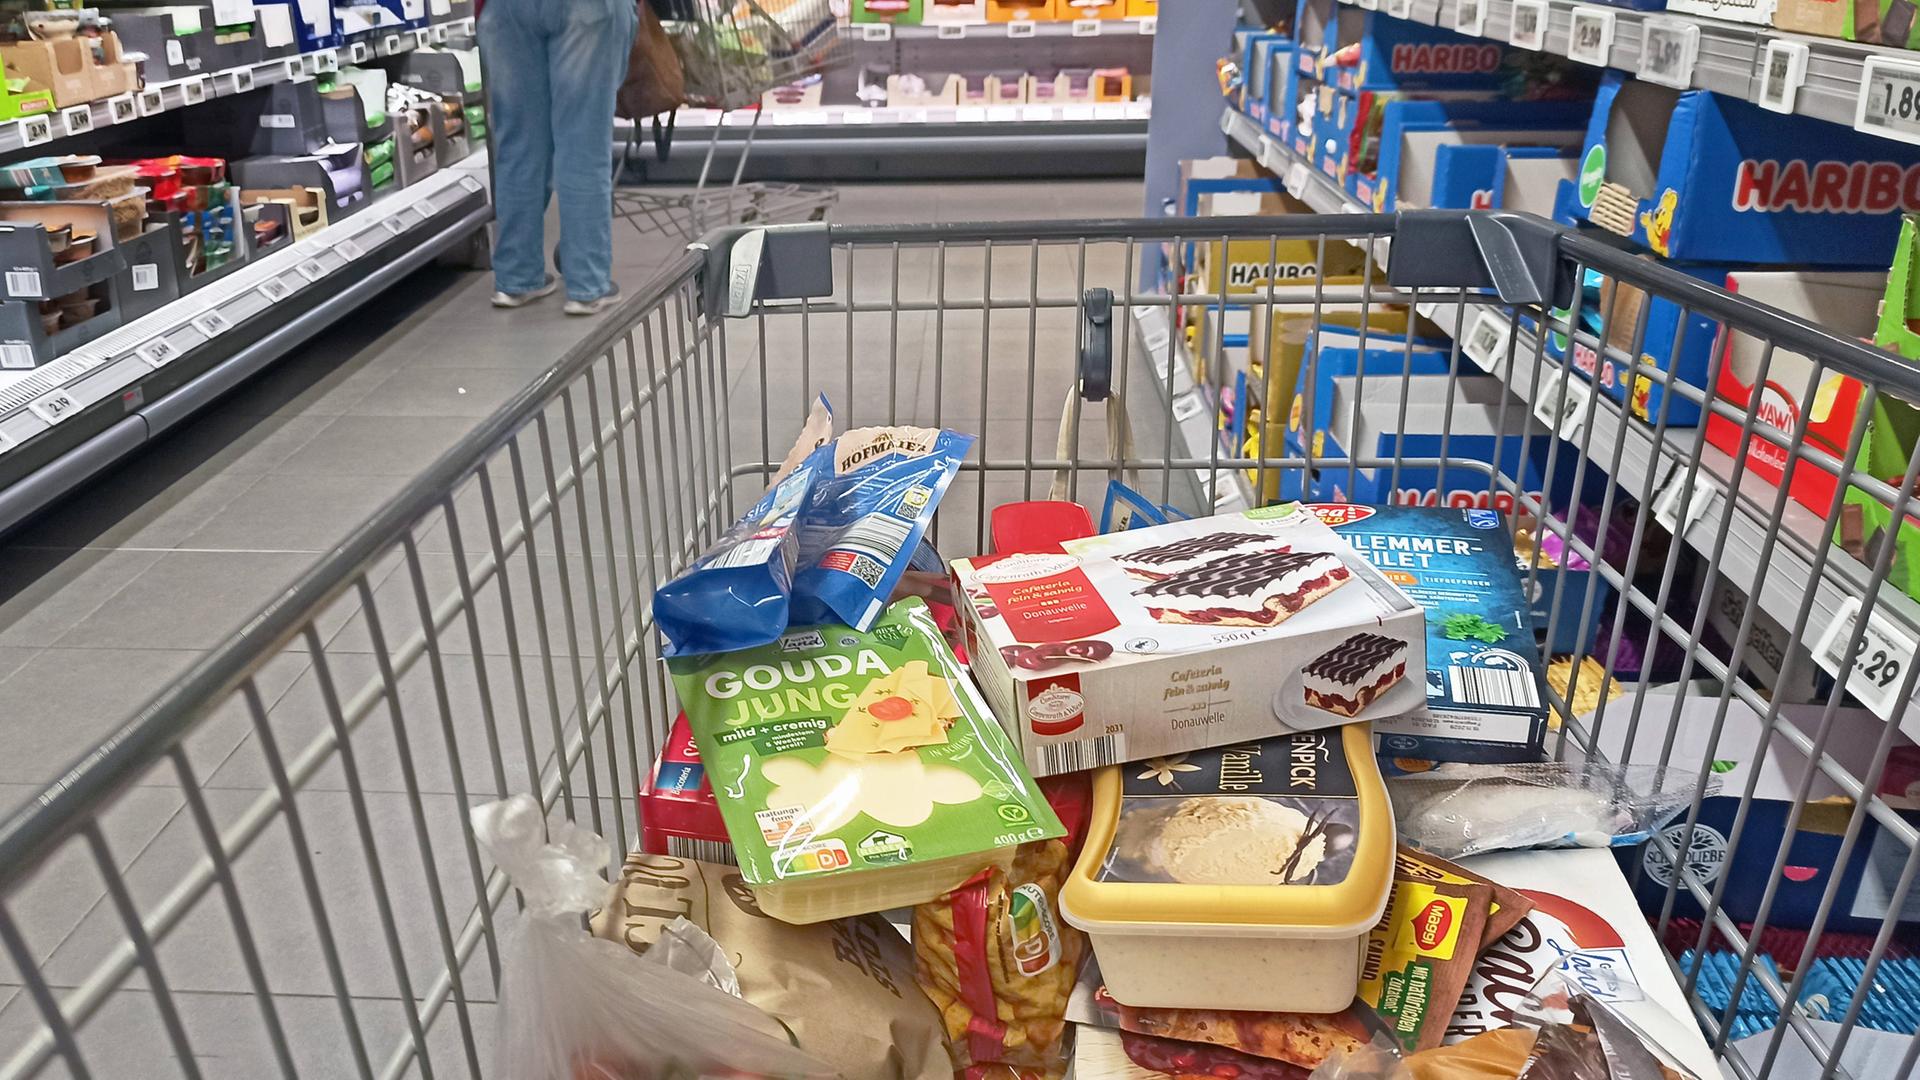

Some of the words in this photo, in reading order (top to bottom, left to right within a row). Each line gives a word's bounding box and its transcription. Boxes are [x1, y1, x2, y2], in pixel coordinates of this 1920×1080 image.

[1392, 44, 1498, 73] HARIBO
[841, 440, 928, 472] HOFMAIER
[1338, 533, 1483, 556] HLEMMER-
[1007, 593, 1031, 605] fein
[1042, 585, 1083, 598] sahnig
[1013, 580, 1071, 595] Cafeteria
[1023, 602, 1088, 620] Donauwelle
[1213, 633, 1238, 644] 550
[1240, 632, 1250, 642] g
[704, 649, 891, 699] GOUDA
[1171, 665, 1222, 682] Cafeteria
[723, 682, 858, 727] JUNG
[1105, 724, 1123, 734] 2031
[1171, 712, 1225, 730] Donauwelle
[722, 726, 756, 742] mild
[1219, 744, 1263, 791] Vanille
[1290, 733, 1317, 790] ENPICK
[993, 832, 1017, 847] 400
[1018, 833, 1026, 842] g
[1646, 849, 1726, 863] SCOLIEBE
[1421, 904, 1445, 945] Maggi
[1411, 965, 1429, 979] Mit
[1397, 980, 1427, 1033] natürlichen
